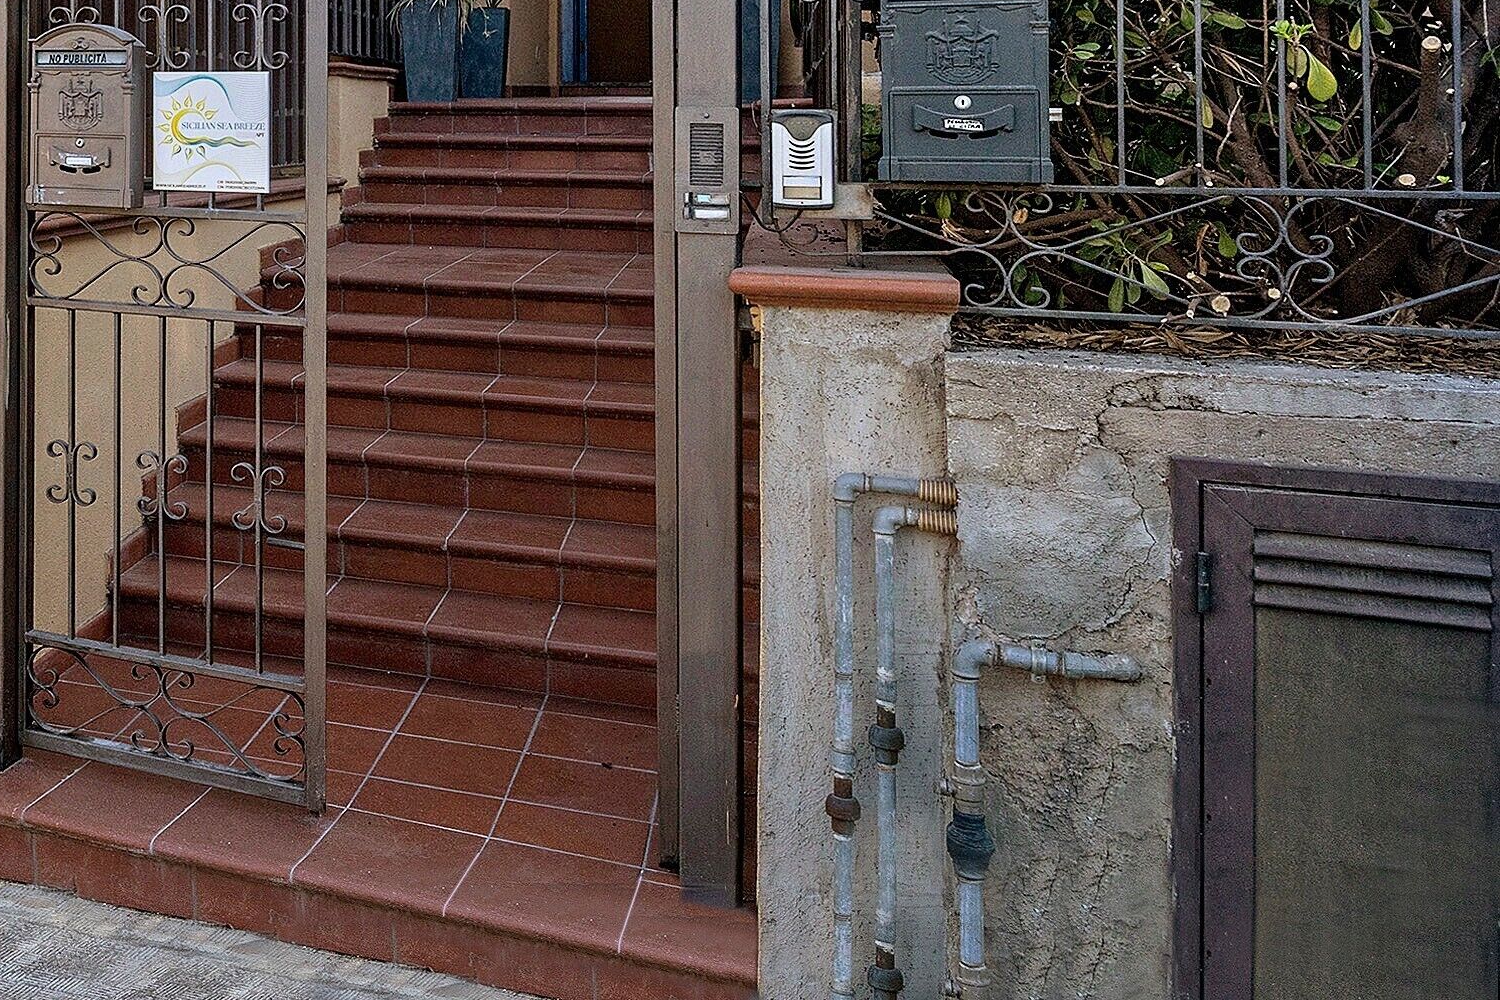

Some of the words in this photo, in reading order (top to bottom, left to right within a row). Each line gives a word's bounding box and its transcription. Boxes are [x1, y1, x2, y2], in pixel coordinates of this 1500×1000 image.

[49, 54, 62, 64] NO
[181, 121, 216, 130] SICILIAN
[216, 122, 233, 130] SEA
[234, 122, 266, 131] BREEZE
